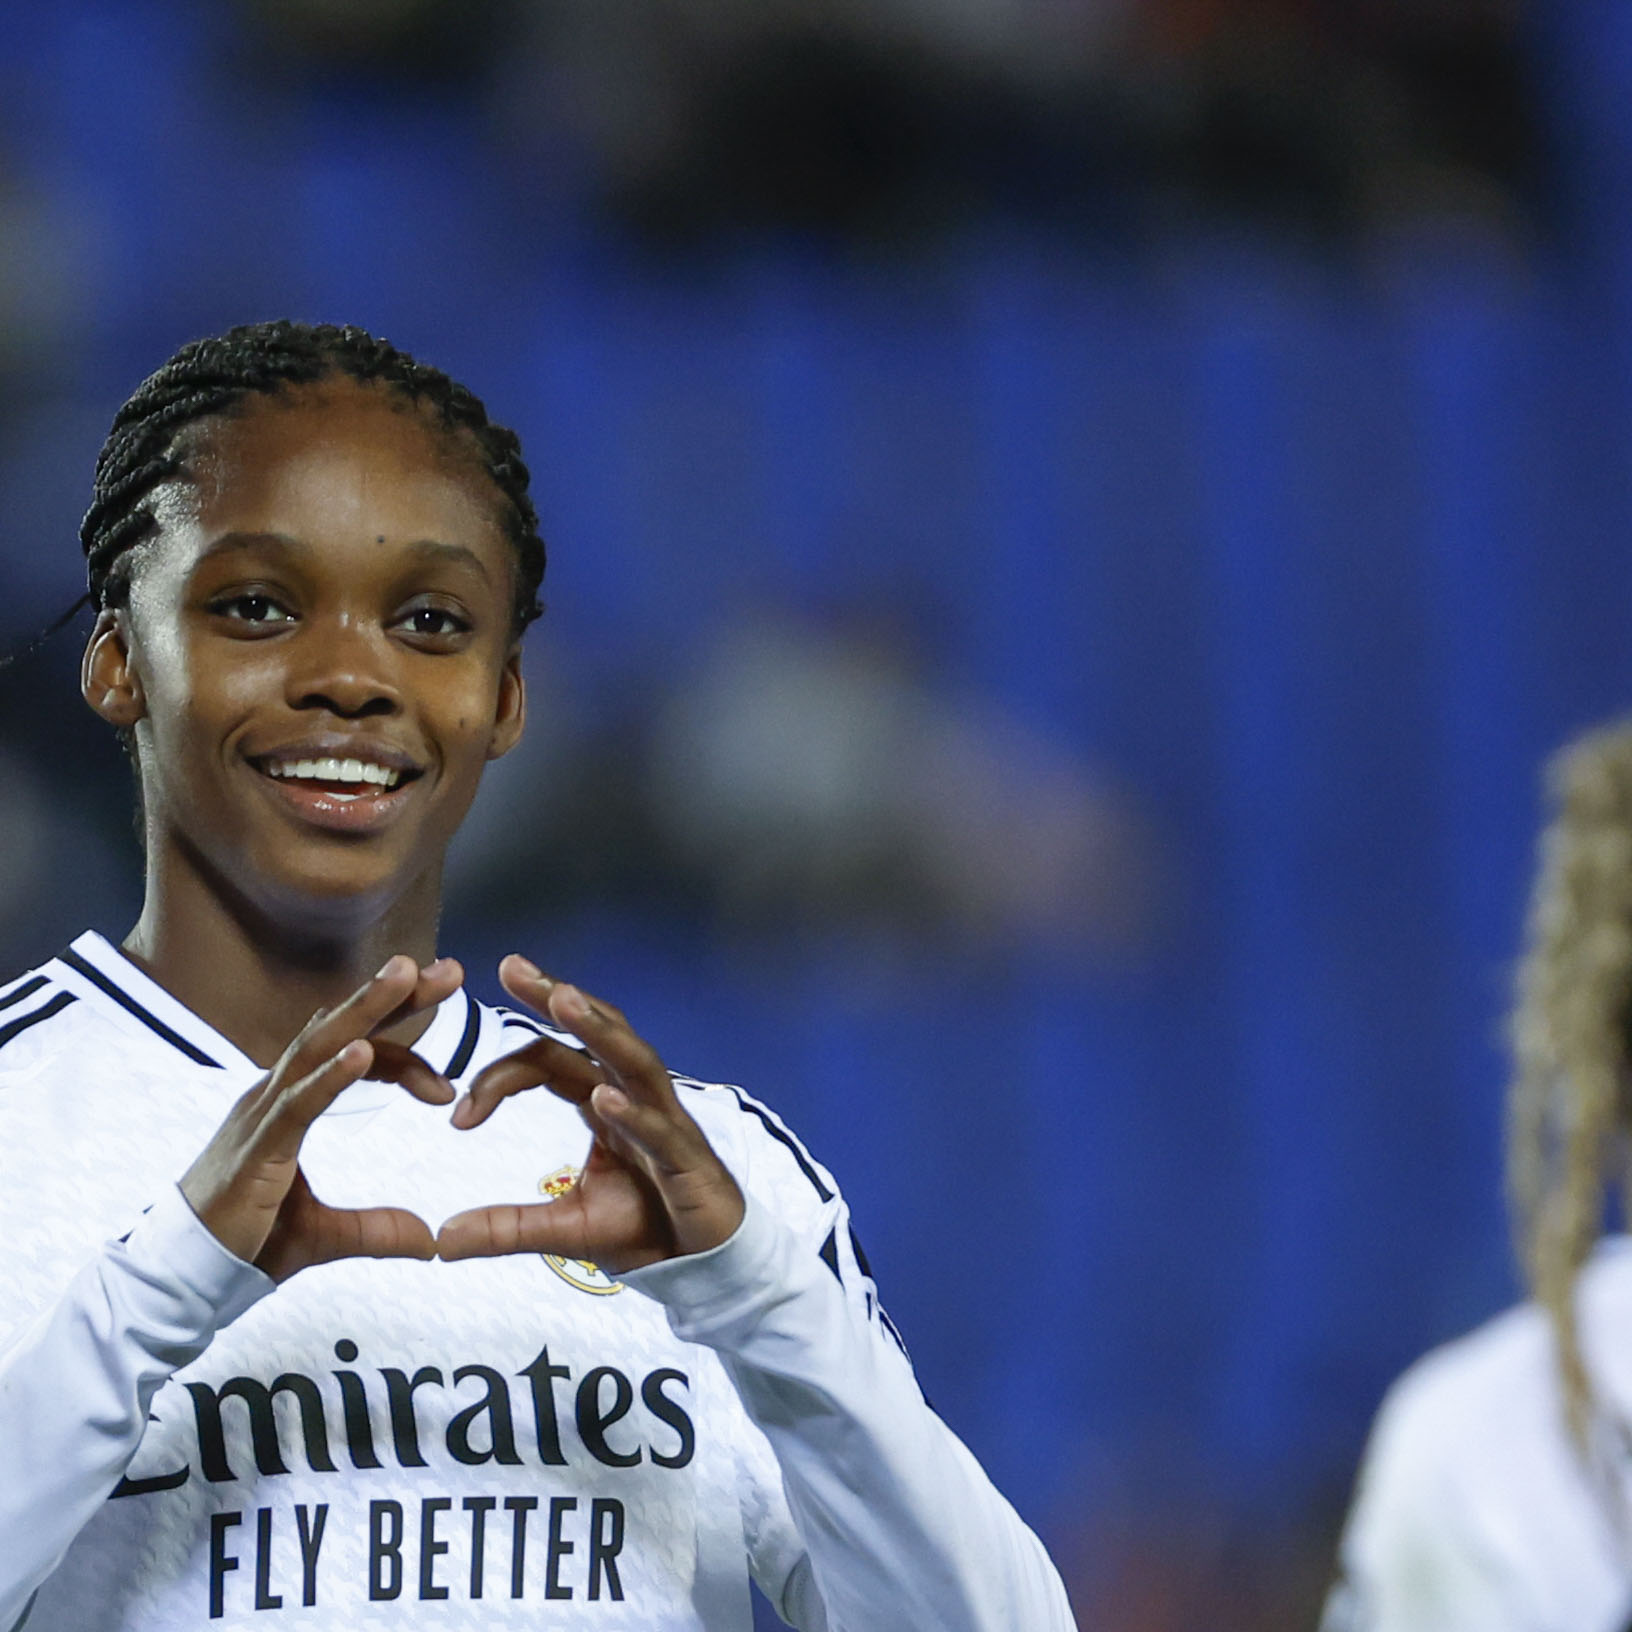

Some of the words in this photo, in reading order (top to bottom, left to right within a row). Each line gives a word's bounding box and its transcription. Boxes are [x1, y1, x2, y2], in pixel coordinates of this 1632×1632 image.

[105, 1338, 696, 1500] mirates
[208, 1503, 330, 1620] FLY
[368, 1496, 626, 1602] BETTER
